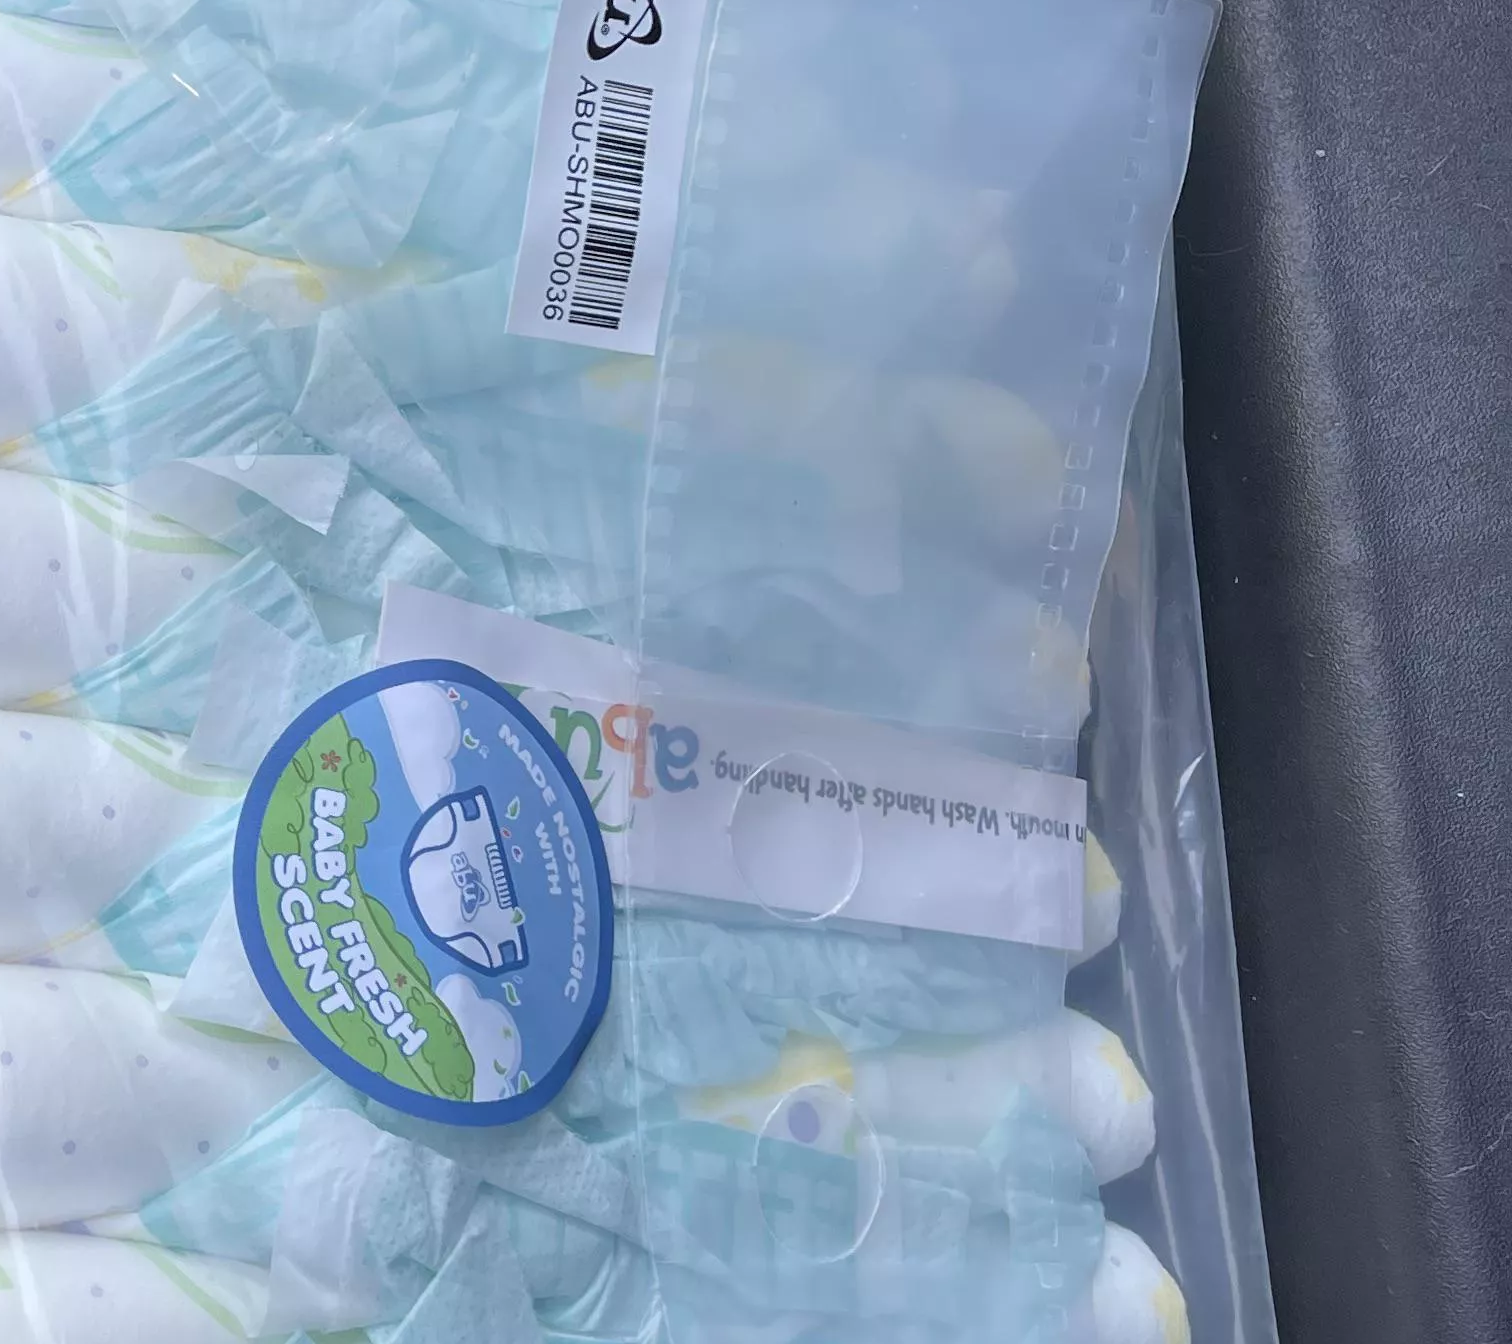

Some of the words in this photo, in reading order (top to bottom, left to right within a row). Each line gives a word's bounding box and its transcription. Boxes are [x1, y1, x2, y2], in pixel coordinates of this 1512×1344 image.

[542, 74, 599, 321] ABU-SHMO0036
[710, 750, 810, 803] handling.
[815, 778, 867, 813] after
[873, 786, 935, 826] hands
[312, 786, 355, 910] BABY
[942, 798, 1000, 837] Wash
[1004, 810, 1070, 841] mouth.
[498, 723, 558, 808] MADE
[551, 810, 588, 1004] NOSTALGIC
[534, 822, 562, 896] WITH
[272, 853, 356, 1016] SCENT
[330, 919, 429, 1056] FRESH
